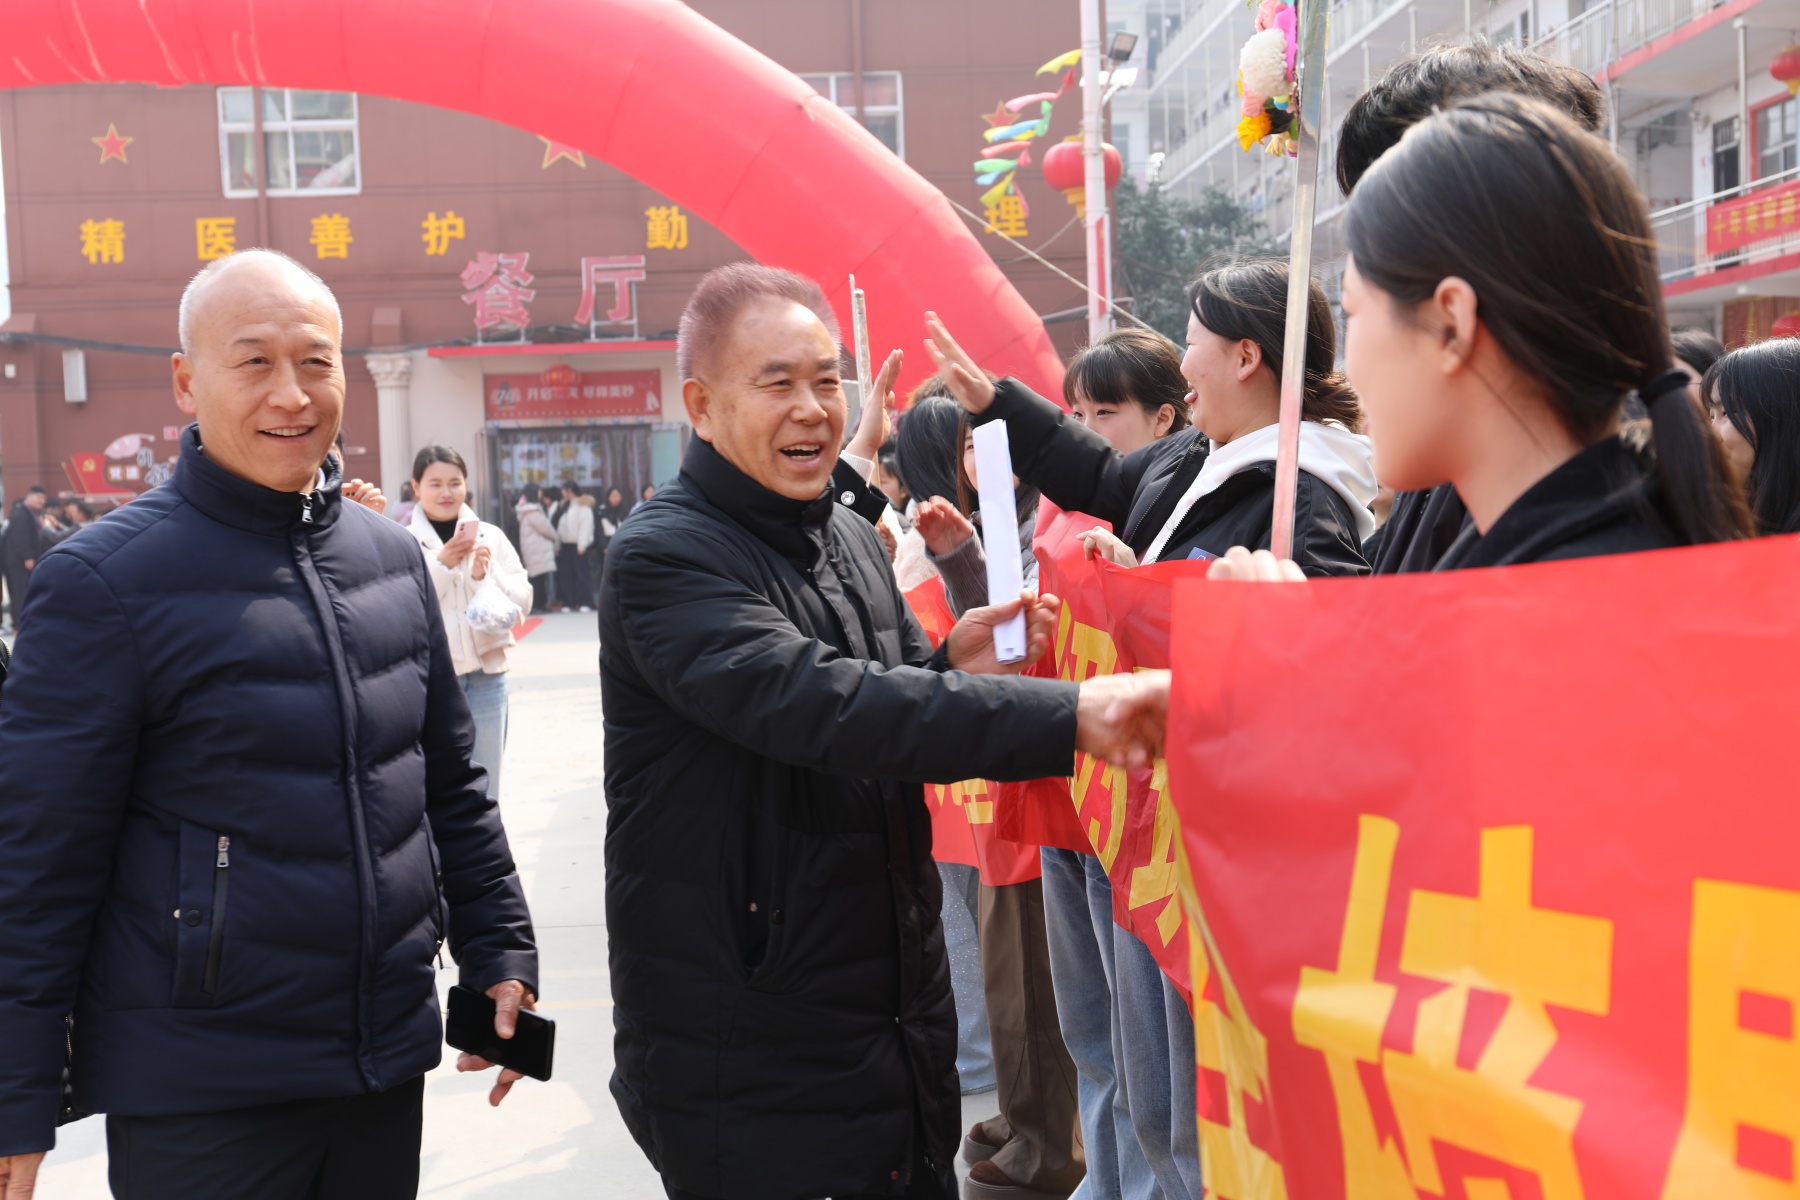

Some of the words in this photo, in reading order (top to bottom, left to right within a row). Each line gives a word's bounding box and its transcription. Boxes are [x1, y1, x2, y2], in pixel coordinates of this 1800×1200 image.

[80, 210, 466, 264] 精医善护
[460, 251, 647, 329] 餐厅
